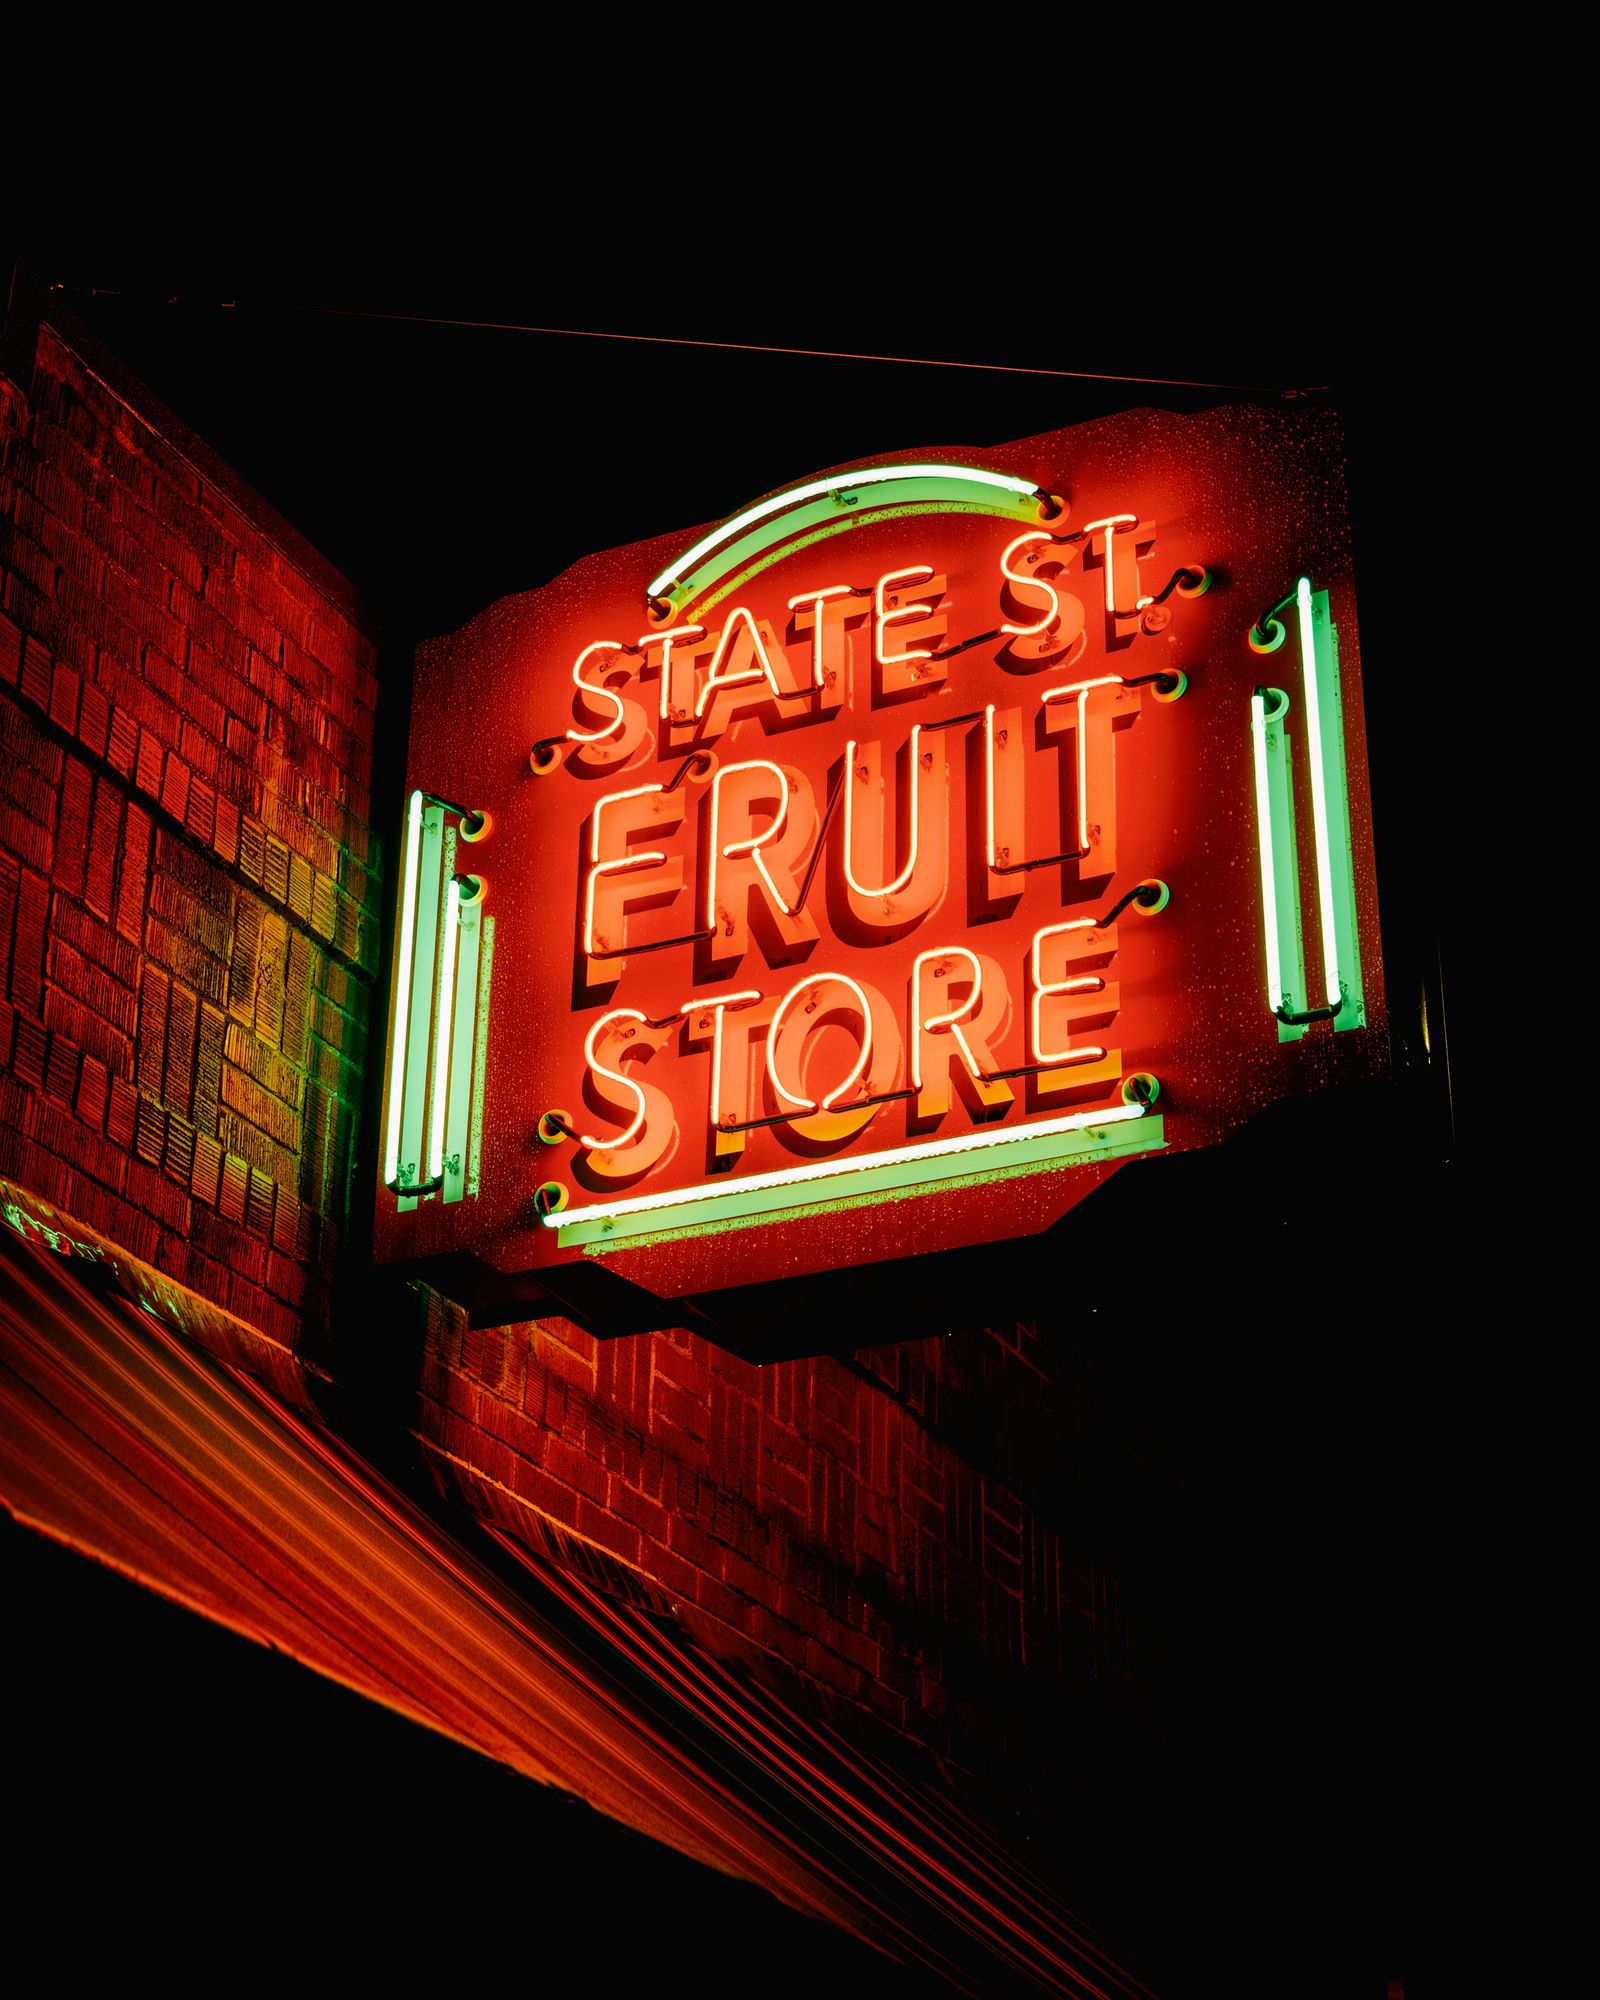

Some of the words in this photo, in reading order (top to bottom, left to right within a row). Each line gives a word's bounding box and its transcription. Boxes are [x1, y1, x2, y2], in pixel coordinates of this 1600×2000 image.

[567, 565, 948, 768] STATE
[580, 675, 1142, 988] FRUIT
[576, 918, 1123, 1179] STORE
